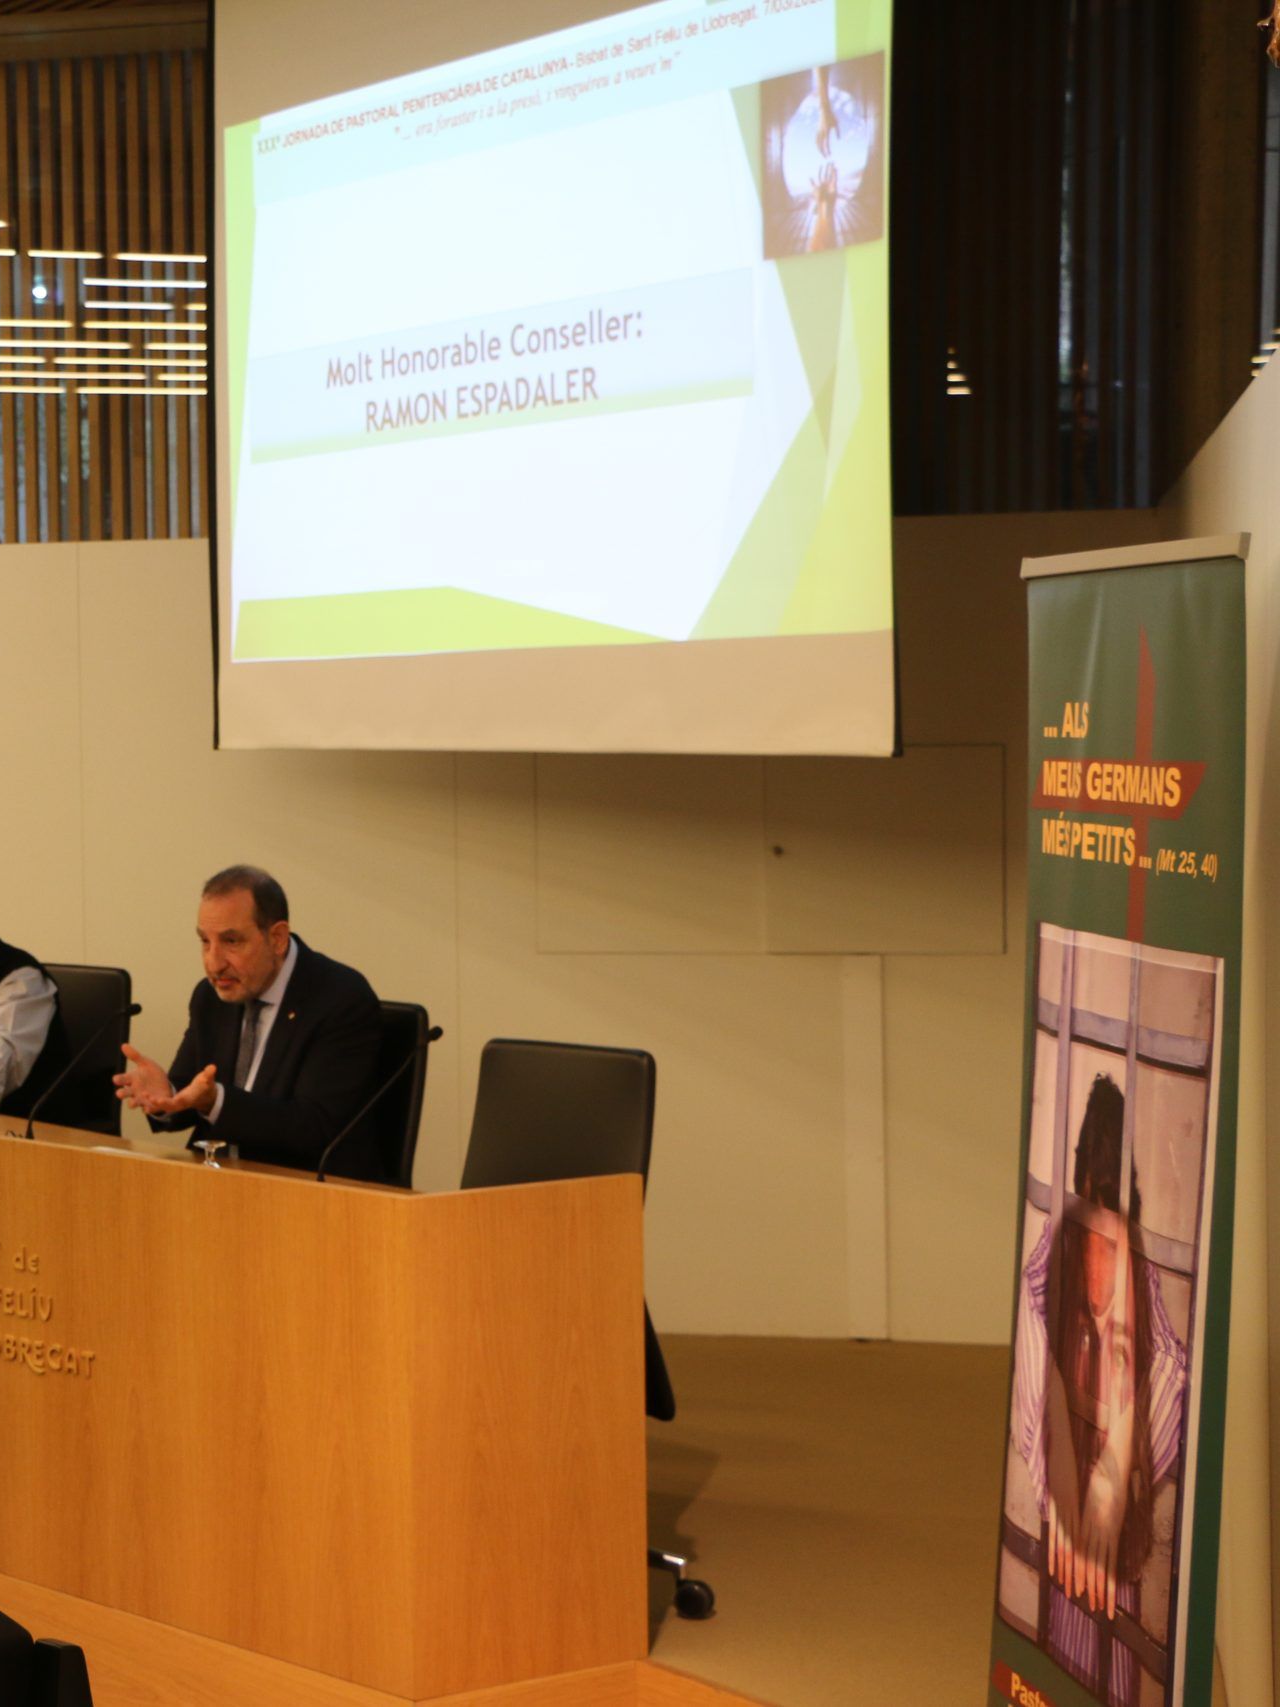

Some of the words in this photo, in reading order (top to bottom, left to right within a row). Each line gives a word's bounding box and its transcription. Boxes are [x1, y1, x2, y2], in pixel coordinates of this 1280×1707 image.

[282, 124, 329, 147] JORNADA
[331, 117, 345, 133] DE
[346, 104, 400, 130] PASTORAL
[483, 75, 498, 93] DE
[501, 57, 568, 87] CATALUNYA
[575, 47, 608, 69] Bisbat
[610, 42, 624, 58] de
[627, 33, 652, 53] Sant
[655, 26, 681, 46] Feliu
[684, 20, 699, 37] de
[326, 351, 373, 389] Molt
[380, 330, 502, 380] Honorable
[510, 308, 643, 357] Conseller:
[365, 388, 448, 433] RAMON
[456, 366, 599, 420] ESPADALER
[1061, 702, 1090, 739] ALS
[1043, 760, 1082, 799] MEUS
[1086, 762, 1182, 807] GERMANS
[1156, 849, 1176, 876] (Mt
[1178, 851, 1198, 879] 25,
[1201, 853, 1218, 883] 40)
[13, 1247, 40, 1274] de
